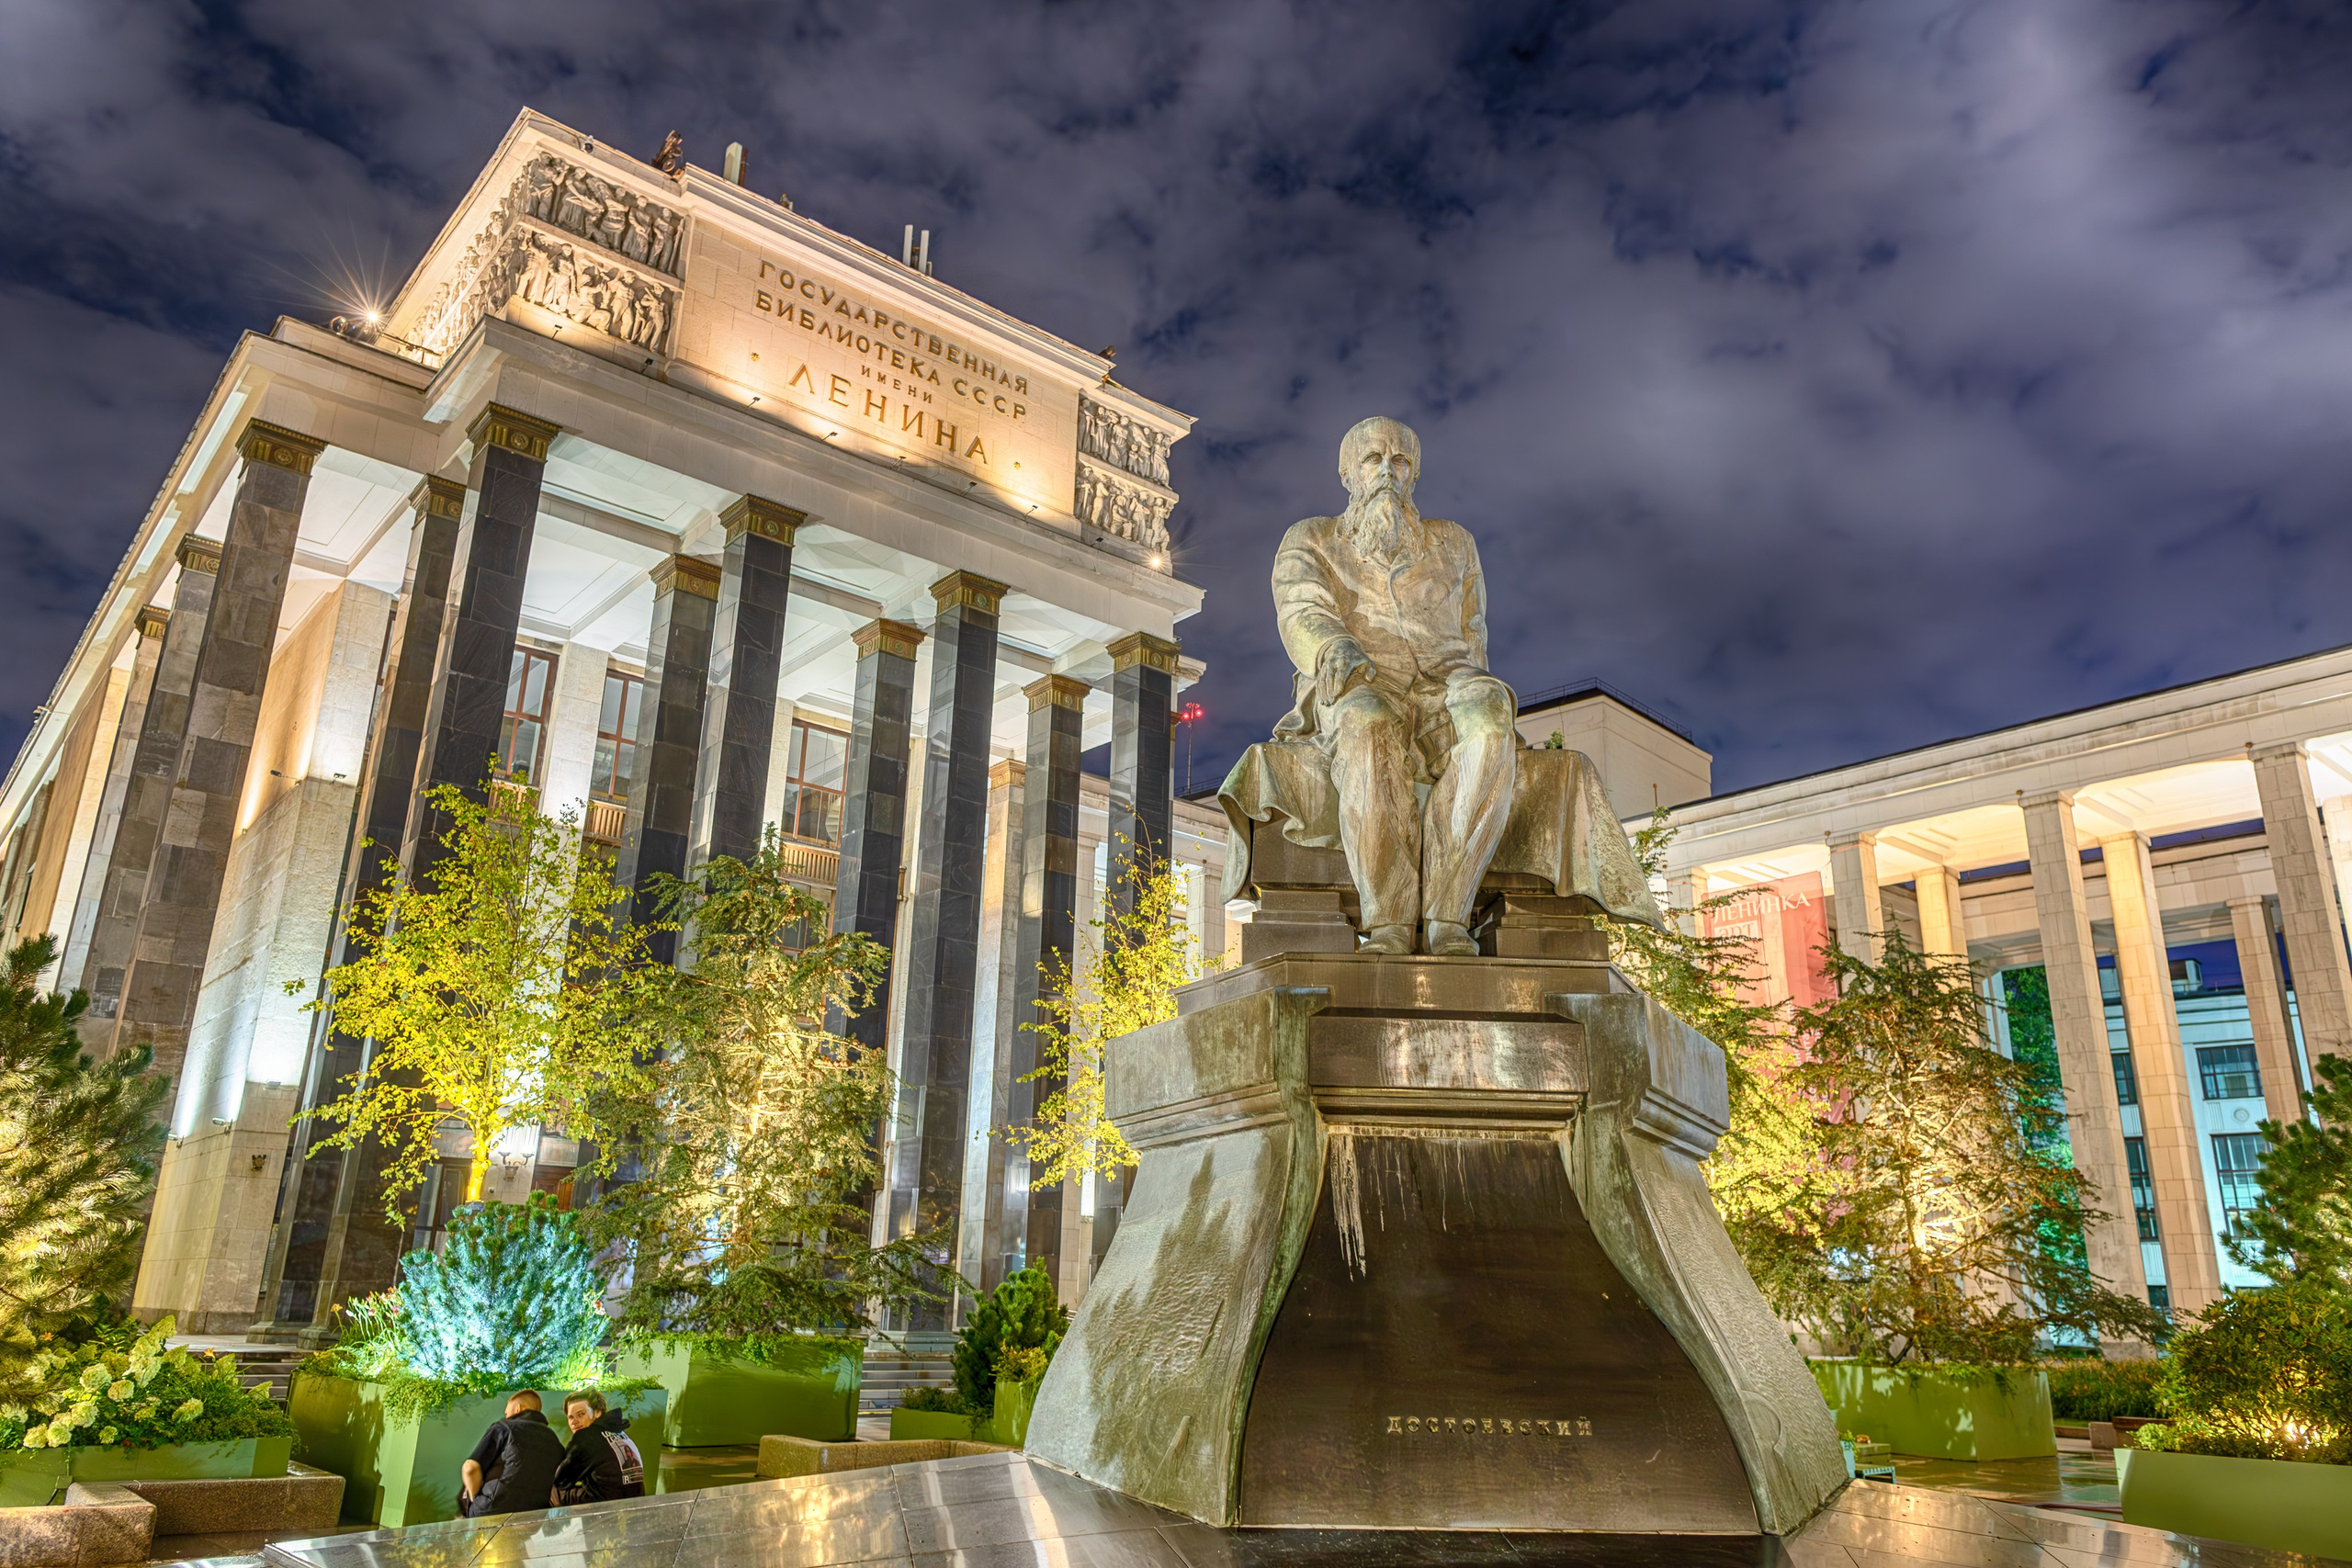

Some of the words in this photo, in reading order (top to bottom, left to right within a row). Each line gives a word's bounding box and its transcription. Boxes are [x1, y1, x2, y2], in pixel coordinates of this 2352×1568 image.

[755, 289, 941, 387] БИБЛИОТЕКА
[759, 260, 1028, 396] ГОСУДАРСТВЕННАЯ
[788, 362, 989, 465] ЛЕНИНА
[861, 365, 933, 404] ИМЕНИ
[1713, 892, 1811, 924] ЛЕНИНКА
[1386, 1416, 1593, 1436] ДОСТОЕВСКИЙ
